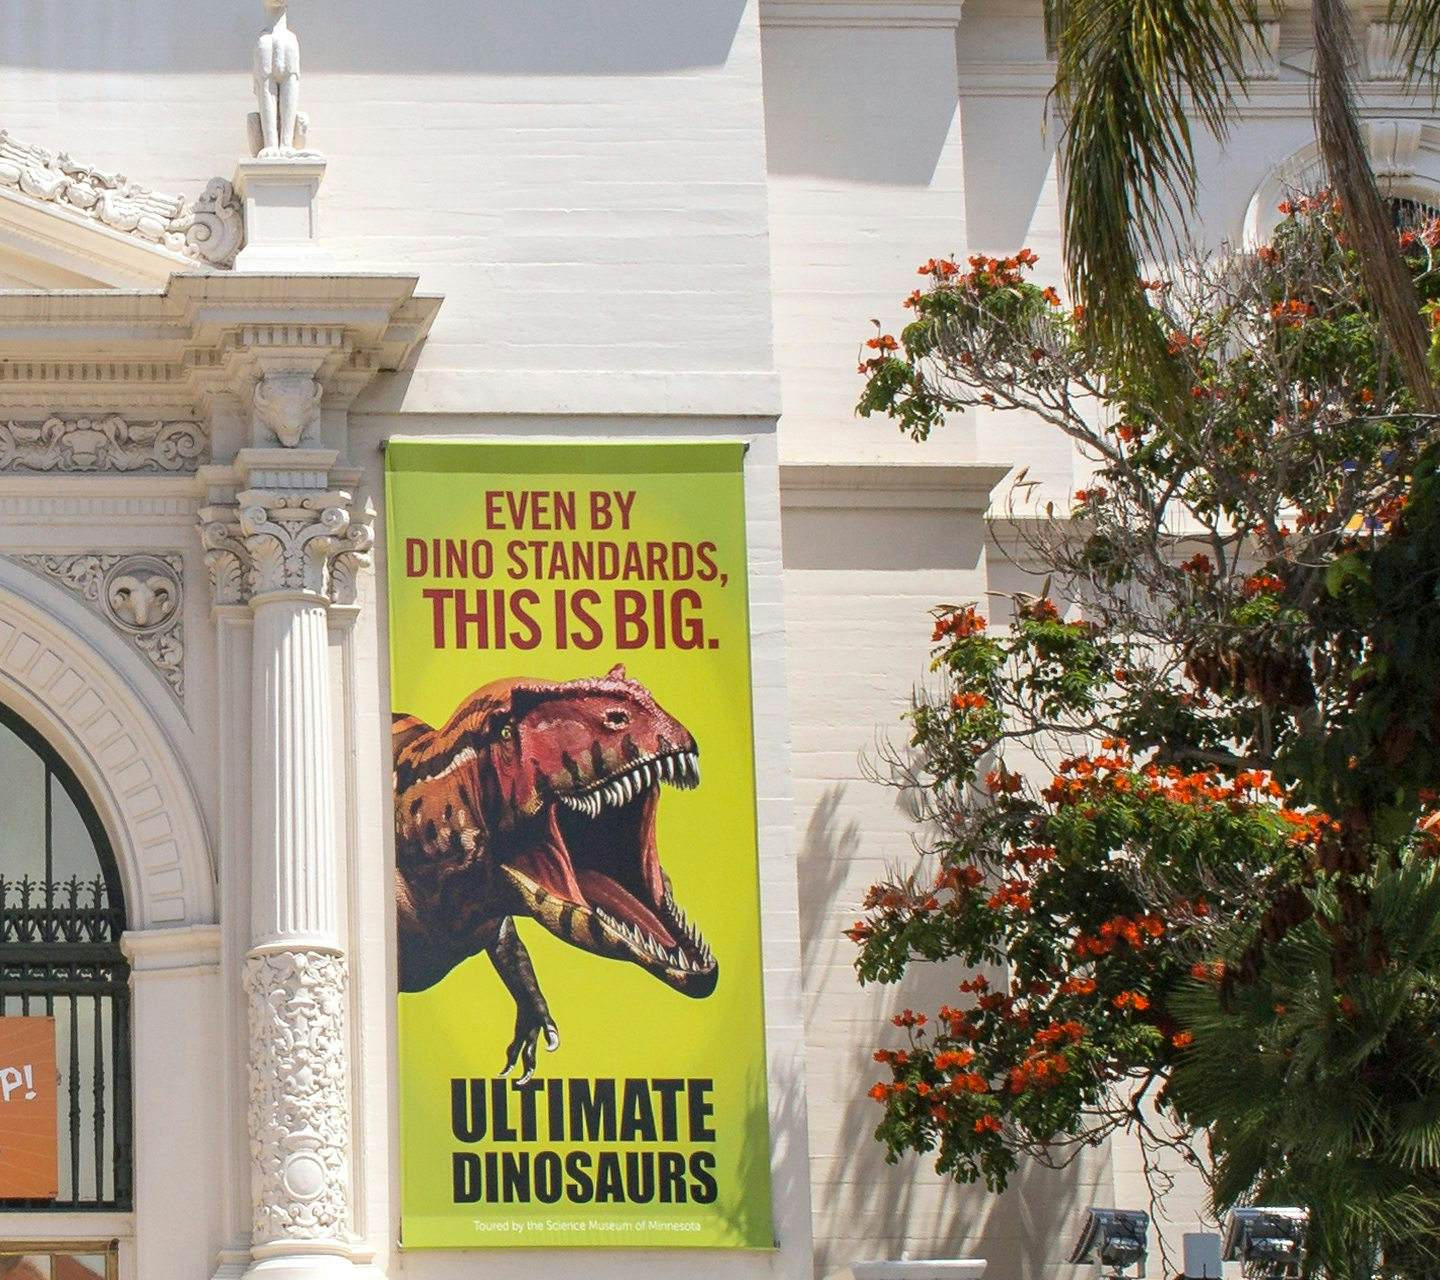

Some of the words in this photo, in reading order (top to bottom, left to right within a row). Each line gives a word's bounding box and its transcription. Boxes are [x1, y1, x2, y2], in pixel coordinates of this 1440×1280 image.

[485, 490, 577, 531] EVEN
[589, 490, 637, 531] BY
[405, 538, 494, 580] DINO
[506, 541, 729, 588] STANDARDS,
[422, 588, 543, 650] THIS
[555, 588, 603, 650] IS
[615, 588, 720, 650] BIG.
[450, 1078, 717, 1143] ULTIMATE
[451, 1150, 719, 1205] DINOSAURS
[474, 1220, 509, 1231] Toured
[511, 1220, 524, 1234] by
[527, 1220, 544, 1231] the
[546, 1220, 586, 1231] Science
[589, 1220, 633, 1232] Museum
[635, 1221, 648, 1232] of
[648, 1221, 702, 1232] Minnesota
